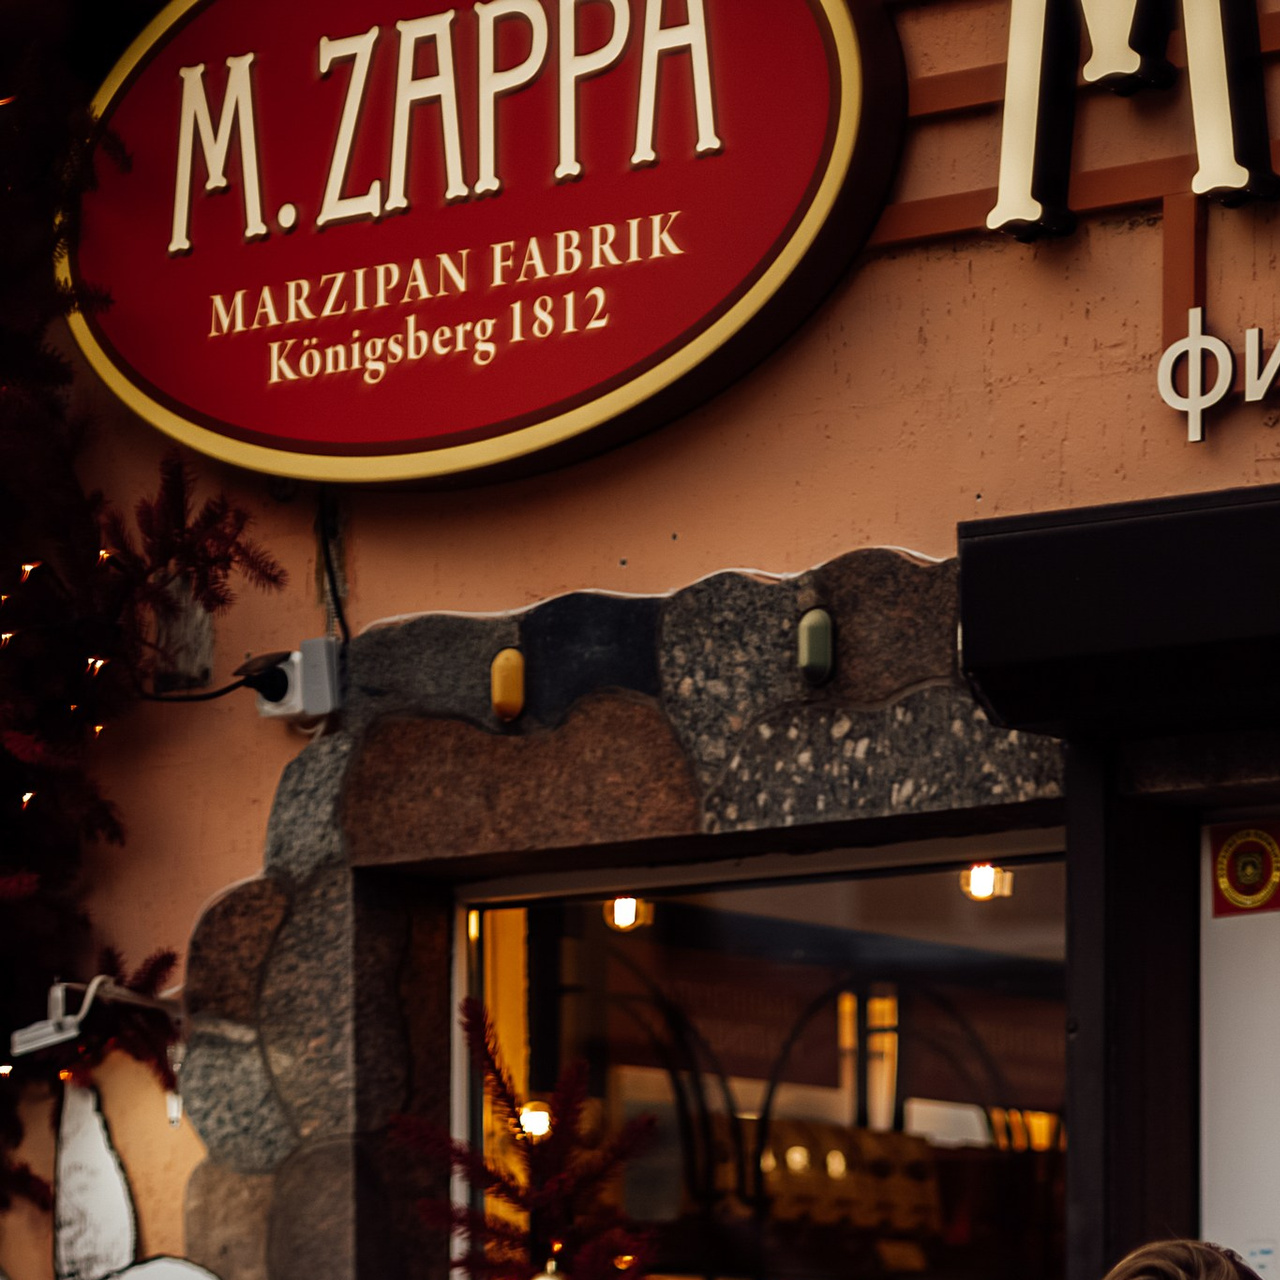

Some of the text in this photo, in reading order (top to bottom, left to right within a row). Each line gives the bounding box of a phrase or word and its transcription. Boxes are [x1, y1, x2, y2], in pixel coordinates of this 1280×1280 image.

[208, 210, 687, 338] MARZIPAN FABRIK
[267, 286, 610, 386] Königsberg 1812
